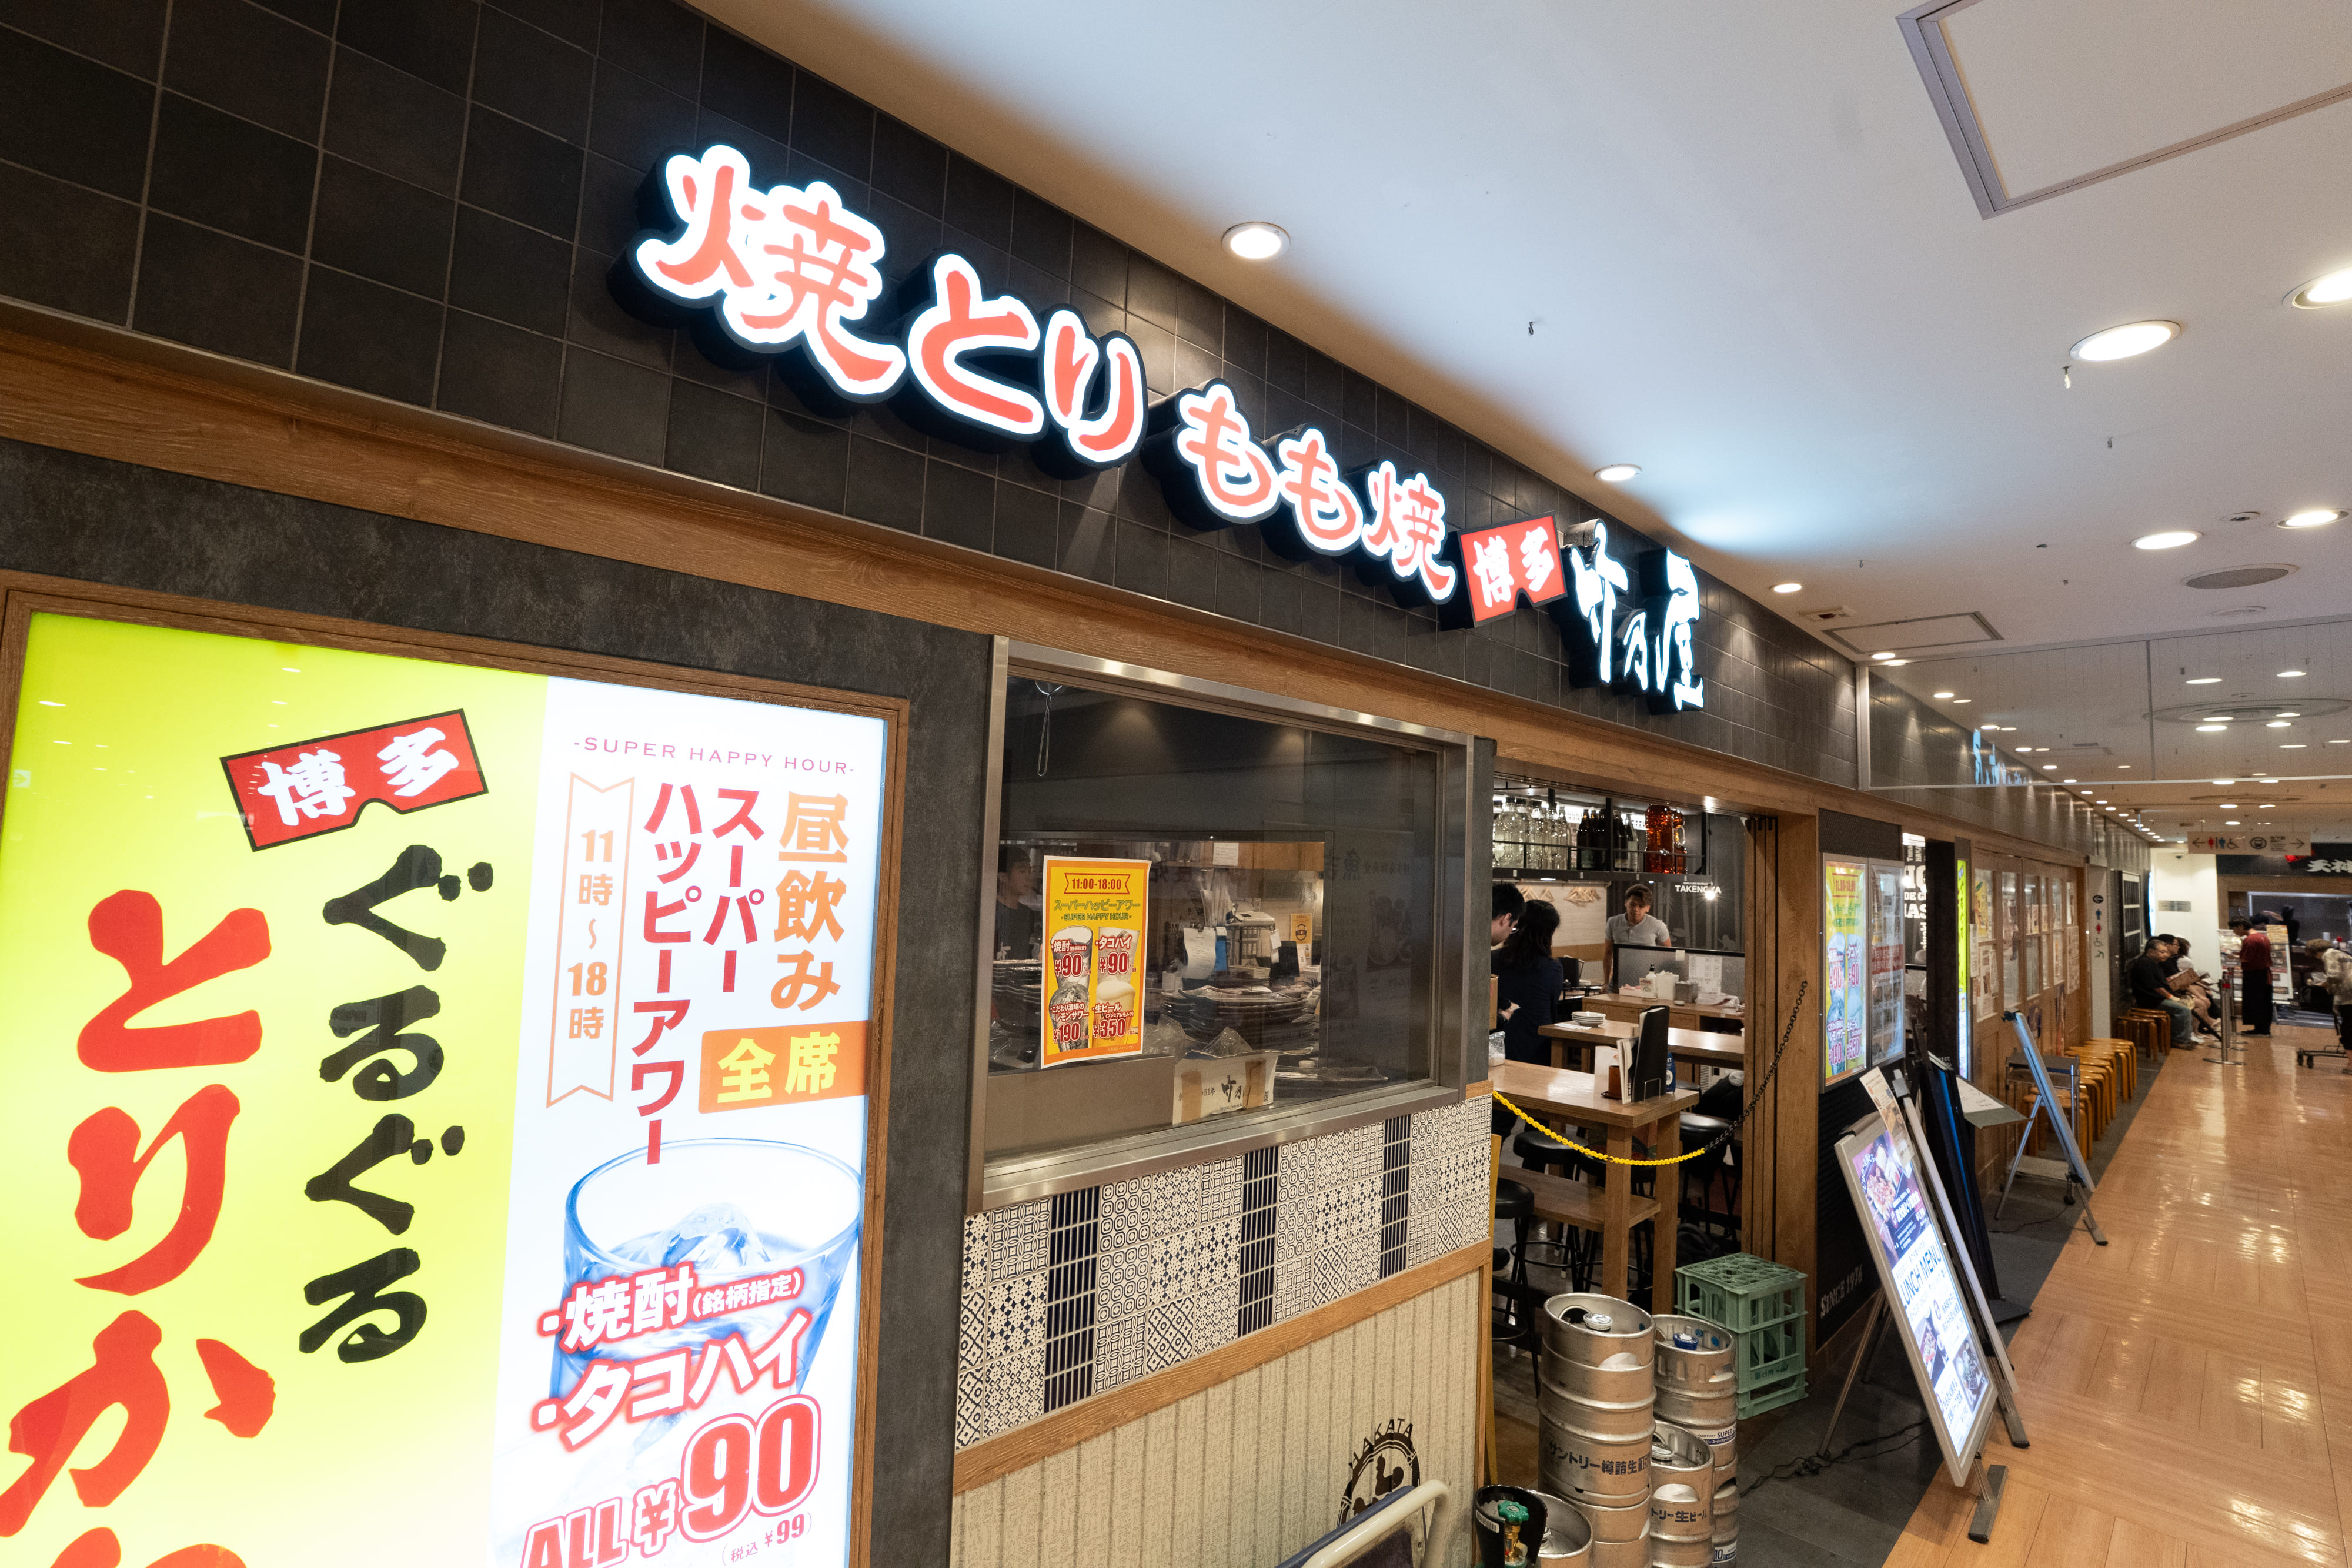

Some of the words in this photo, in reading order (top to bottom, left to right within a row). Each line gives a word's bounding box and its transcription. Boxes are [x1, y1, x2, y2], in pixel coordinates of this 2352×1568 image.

[637, 145, 1143, 463] 焼とり
[1177, 384, 1455, 603] もも焼
[1473, 526, 1554, 607] 博多
[258, 727, 459, 825] 博多
[690, 747, 772, 767] HAPPY
[703, 788, 764, 992] スーパー
[771, 791, 849, 1012] 昼飲み
[1071, 878, 1122, 890] 11:00-18:00
[1086, 912, 1110, 921] HAPPY
[630, 783, 703, 1164] ハッピーアワー
[1054, 954, 1083, 977] ¥90
[1099, 951, 1129, 975] ¥90
[1053, 1022, 1080, 1044] ¥190
[1055, 1011, 1090, 1022] レモンサワー
[1093, 1018, 1127, 1039] ¥350
[717, 1031, 840, 1104] 全席
[299, 844, 494, 1363] ぐるぐる
[0, 889, 276, 1568] とりか
[1919, 1241, 1942, 1280] MENU
[1820, 1279, 1845, 1319] SINCE
[1348, 1417, 1414, 1471] HAKATA
[522, 1497, 628, 1568] ALL
